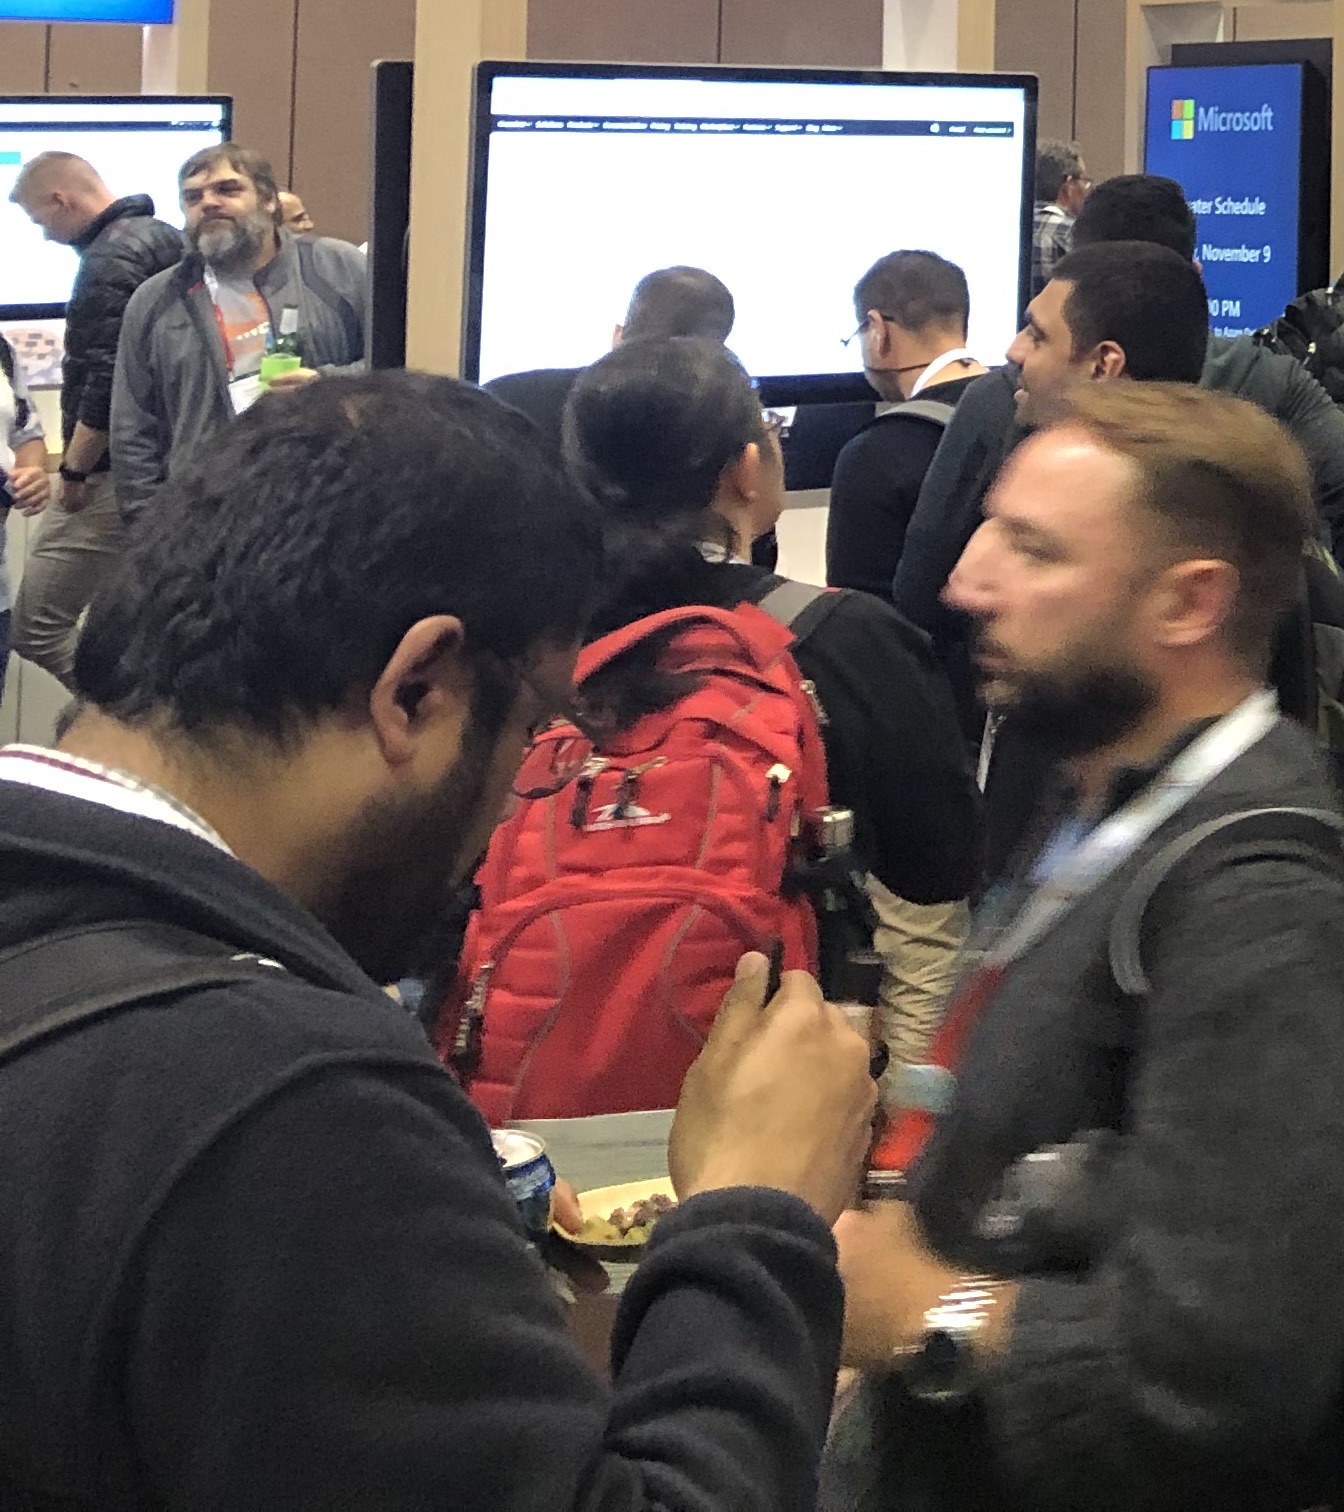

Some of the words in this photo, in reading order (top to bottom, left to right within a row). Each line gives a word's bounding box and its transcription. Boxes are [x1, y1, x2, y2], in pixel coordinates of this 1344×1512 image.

[1197, 103, 1274, 132] Microsoft
[1214, 196, 1267, 216] Schedule
[1202, 243, 1261, 263] November
[1262, 244, 1272, 264] 9
[1221, 299, 1241, 318] PM
